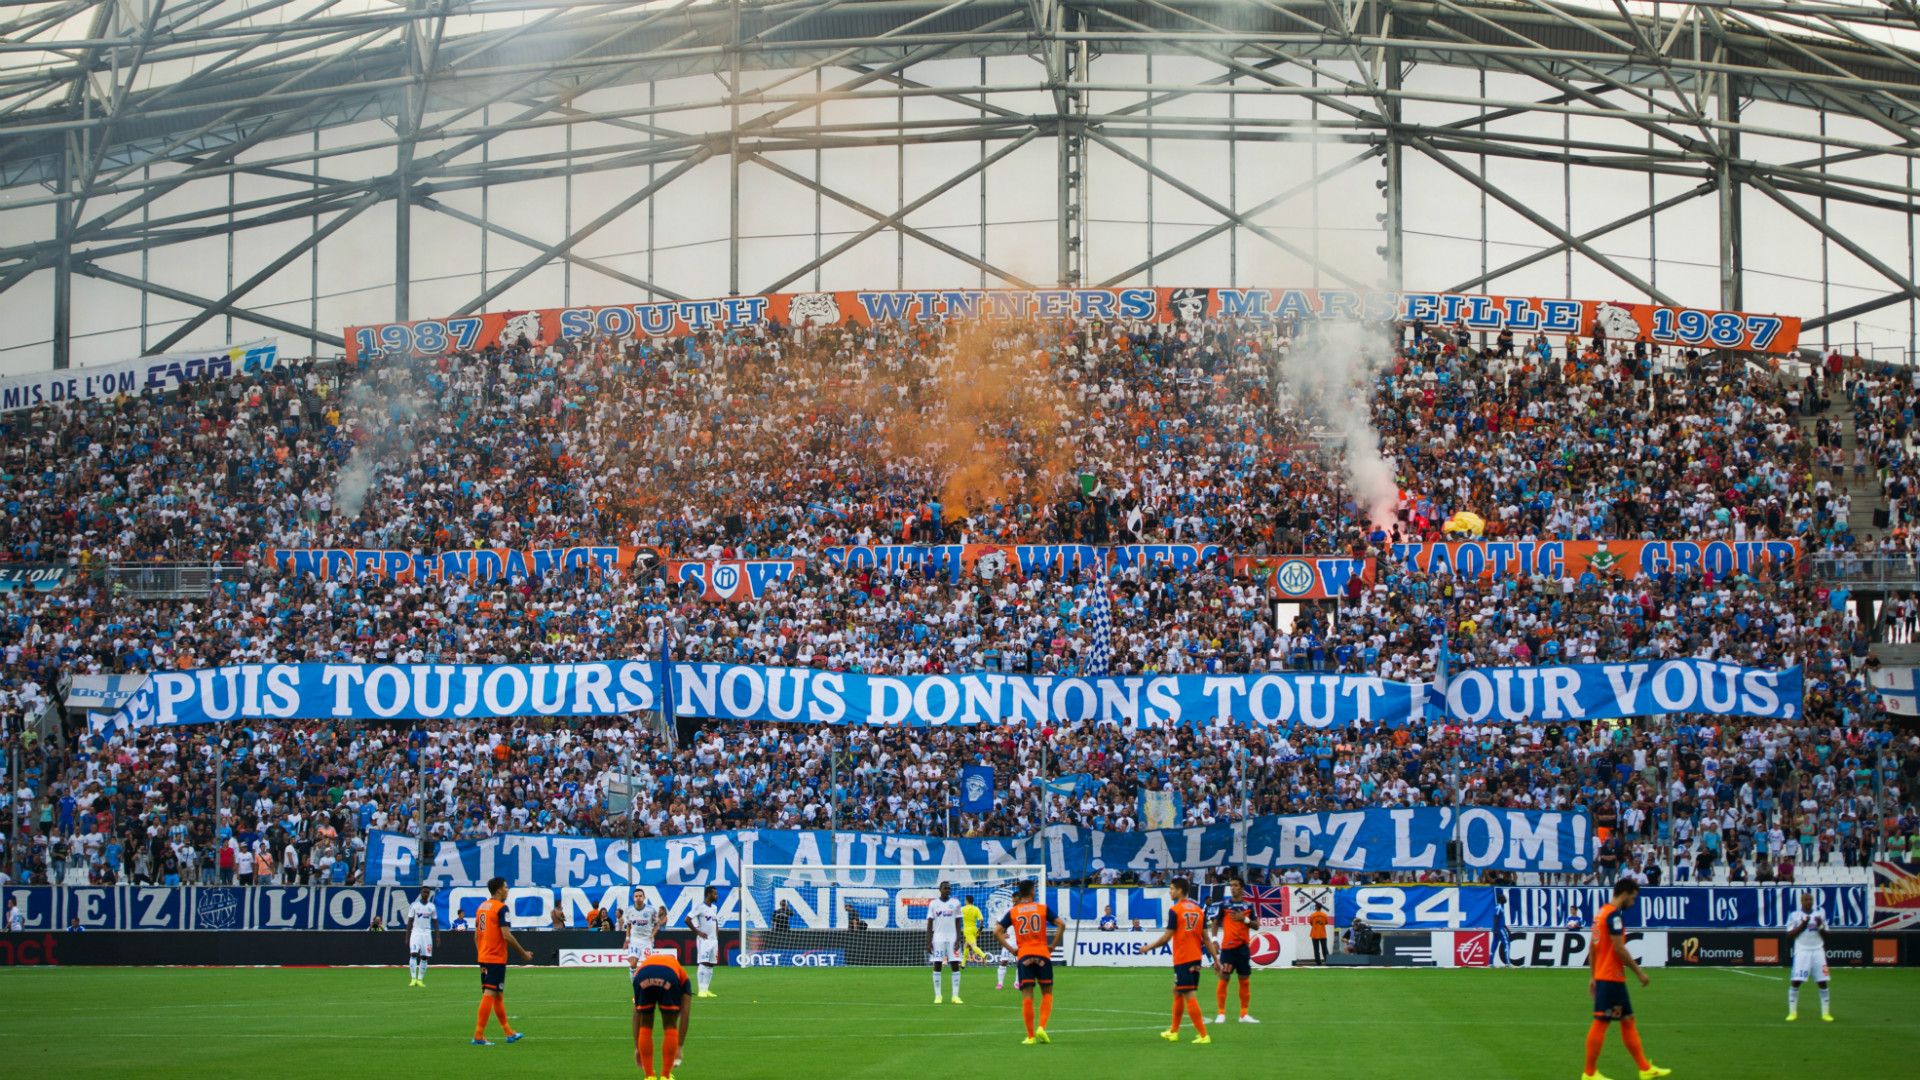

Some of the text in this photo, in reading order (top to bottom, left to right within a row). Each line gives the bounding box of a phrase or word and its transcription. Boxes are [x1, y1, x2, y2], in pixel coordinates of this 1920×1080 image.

[354, 288, 1783, 357] 1987 SOUTH WINNERS MARSEILLE 1987
[51, 378, 77, 401] DE
[86, 370, 136, 397] L'OM
[274, 547, 620, 588] INDEPENDANCE
[1391, 541, 1796, 582] KAOTIC GROUP
[322, 661, 653, 717] TOUJOURS
[675, 664, 847, 724] NOUS
[866, 674, 1182, 729] DONNONS
[1203, 674, 1385, 728] TOUT
[376, 829, 760, 887] FAITES-EN
[1127, 811, 1369, 870] ALLEZ
[1389, 806, 1588, 871] L'OM!
[479, 912, 486, 932] 8
[1016, 913, 1041, 935] 20
[1183, 912, 1199, 930] 17
[1354, 887, 1466, 928] 84
[1640, 896, 1690, 927] pour
[1708, 889, 1738, 921] les
[1671, 937, 1744, 963] le 12 homme
[1826, 949, 1862, 959] omme
